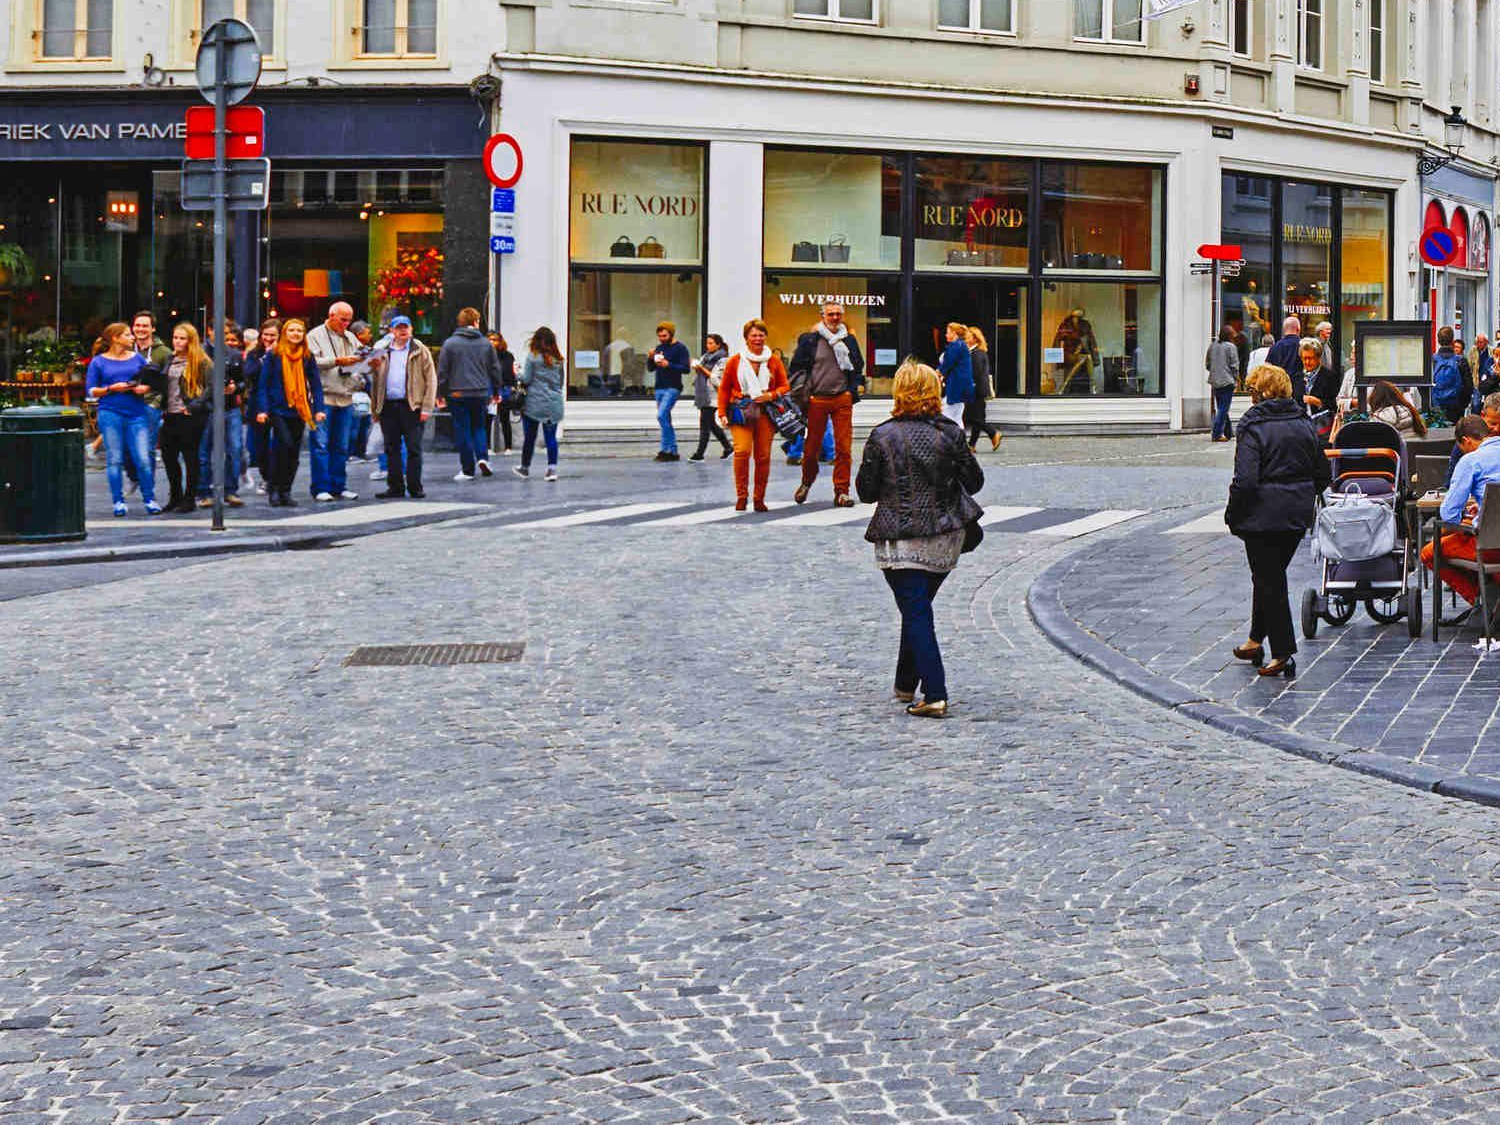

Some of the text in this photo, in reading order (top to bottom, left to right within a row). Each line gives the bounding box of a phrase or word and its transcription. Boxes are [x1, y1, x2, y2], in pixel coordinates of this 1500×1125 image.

[59, 123, 110, 140] VAN
[581, 192, 697, 217] RUE NORD
[924, 205, 1024, 228] RUE NORD
[780, 294, 886, 306] WIJ VERHUIZEN
